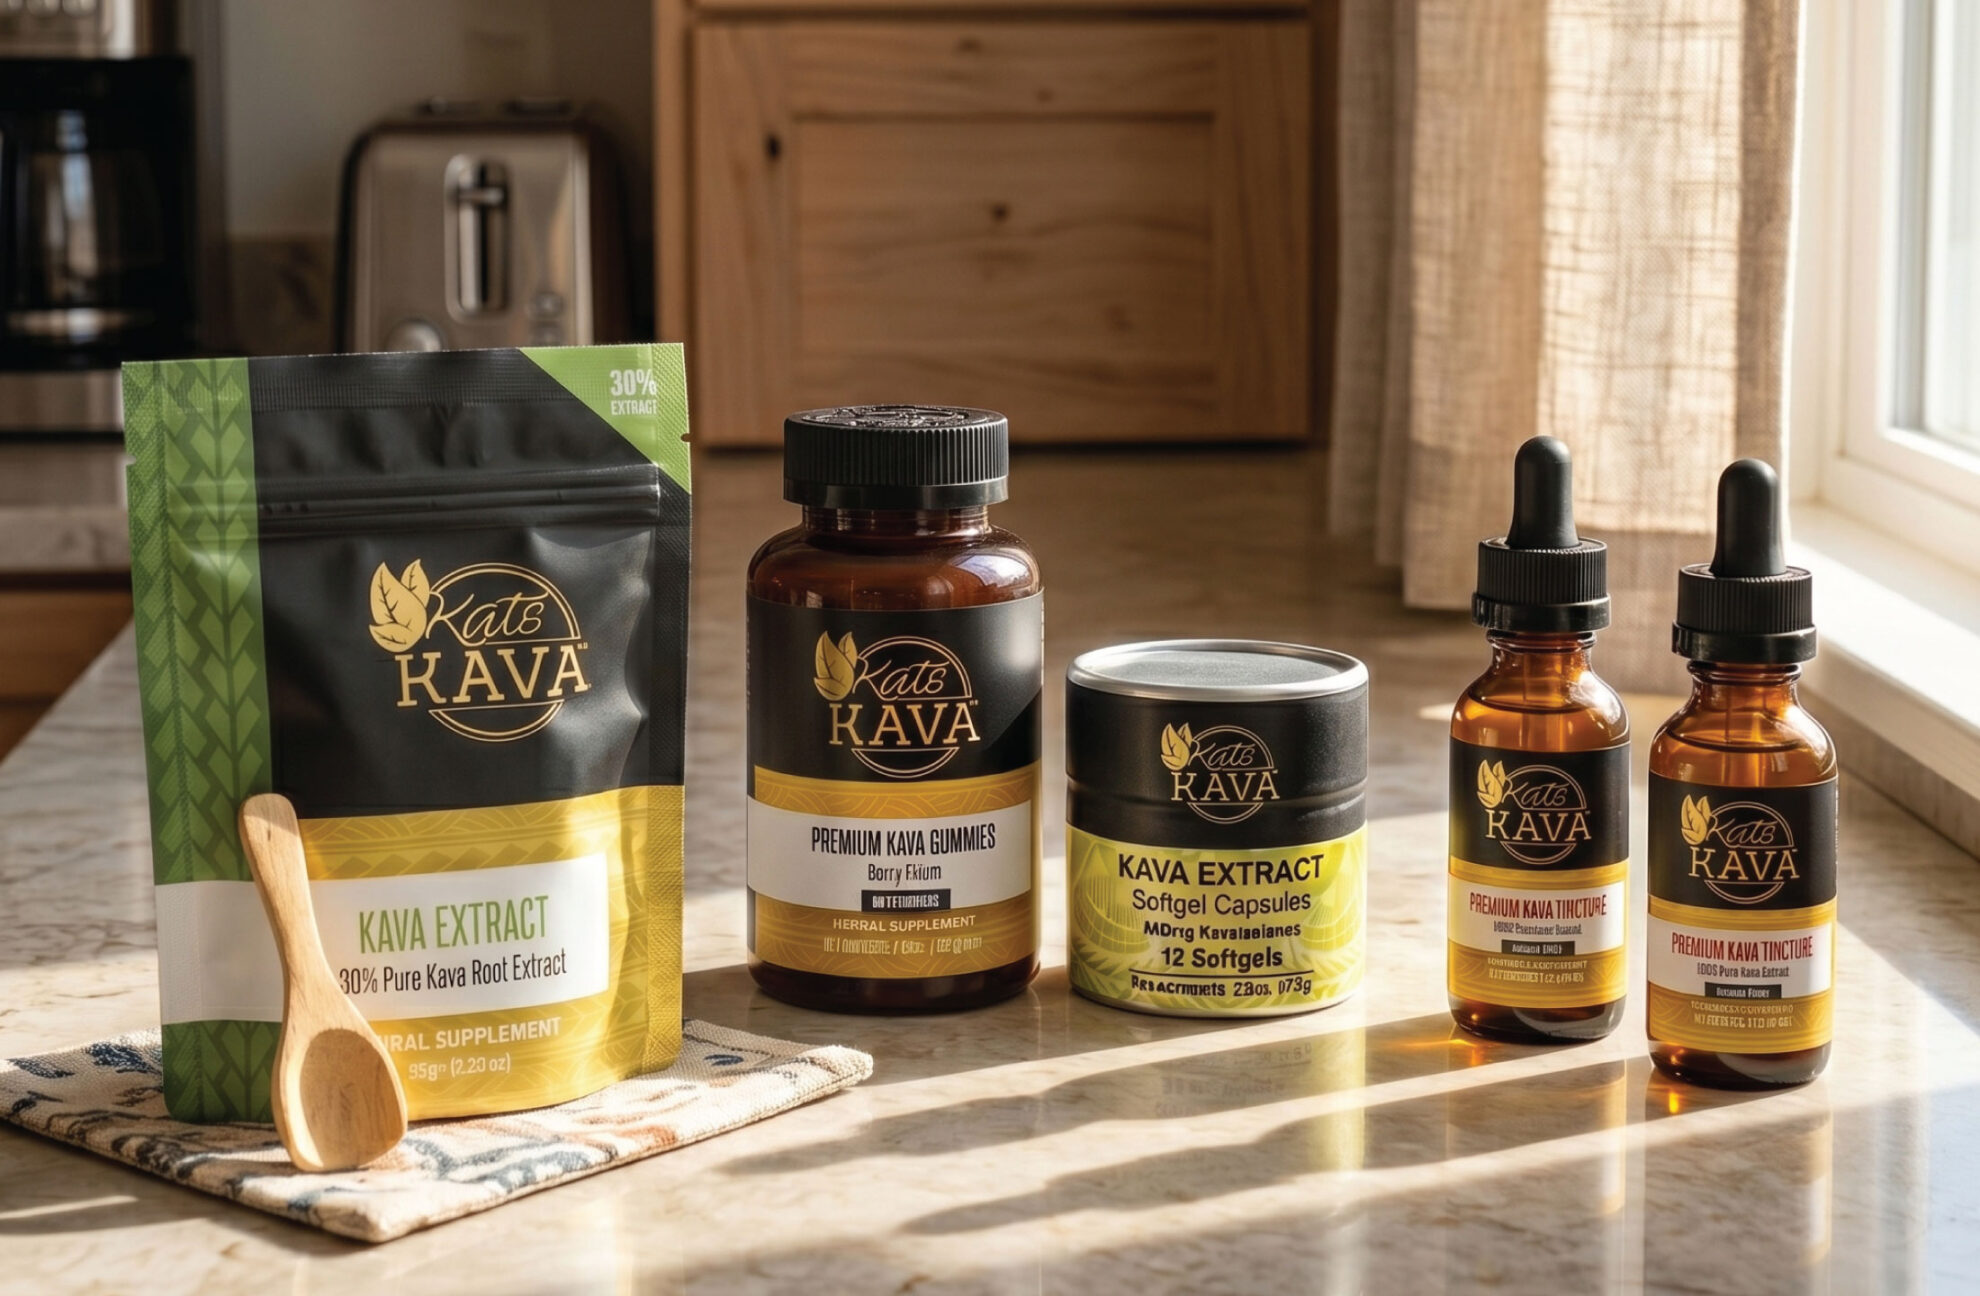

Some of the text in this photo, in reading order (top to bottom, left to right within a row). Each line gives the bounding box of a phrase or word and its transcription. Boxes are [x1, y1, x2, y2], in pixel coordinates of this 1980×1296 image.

[610, 368, 657, 396] 30%
[425, 591, 545, 646] Kats
[395, 644, 590, 707] KAVA
[853, 656, 949, 700] Kats
[829, 702, 981, 746] KAVA
[1171, 770, 1280, 801] KAVA
[811, 823, 996, 856] PREMIUM KAVA GUMMIES
[1485, 809, 1592, 842] KAVA
[1119, 854, 1324, 886] KAVA EXTRACT
[1688, 847, 1800, 881] KAVA
[1132, 889, 1311, 919] Softgel Capsules
[1470, 892, 1519, 918] PREMIUM
[1523, 900, 1553, 919] KAVA
[359, 895, 549, 954] KAVA EXTRACT
[889, 915, 976, 932] SUPPLEMENT
[1161, 946, 1283, 973] 12 Softgels
[1672, 932, 1813, 961] PREMIUM KAVA TINCTURE
[340, 948, 567, 994] 30% Pure Kava Root Extract
[436, 1017, 561, 1049] SUPPLEMENT
